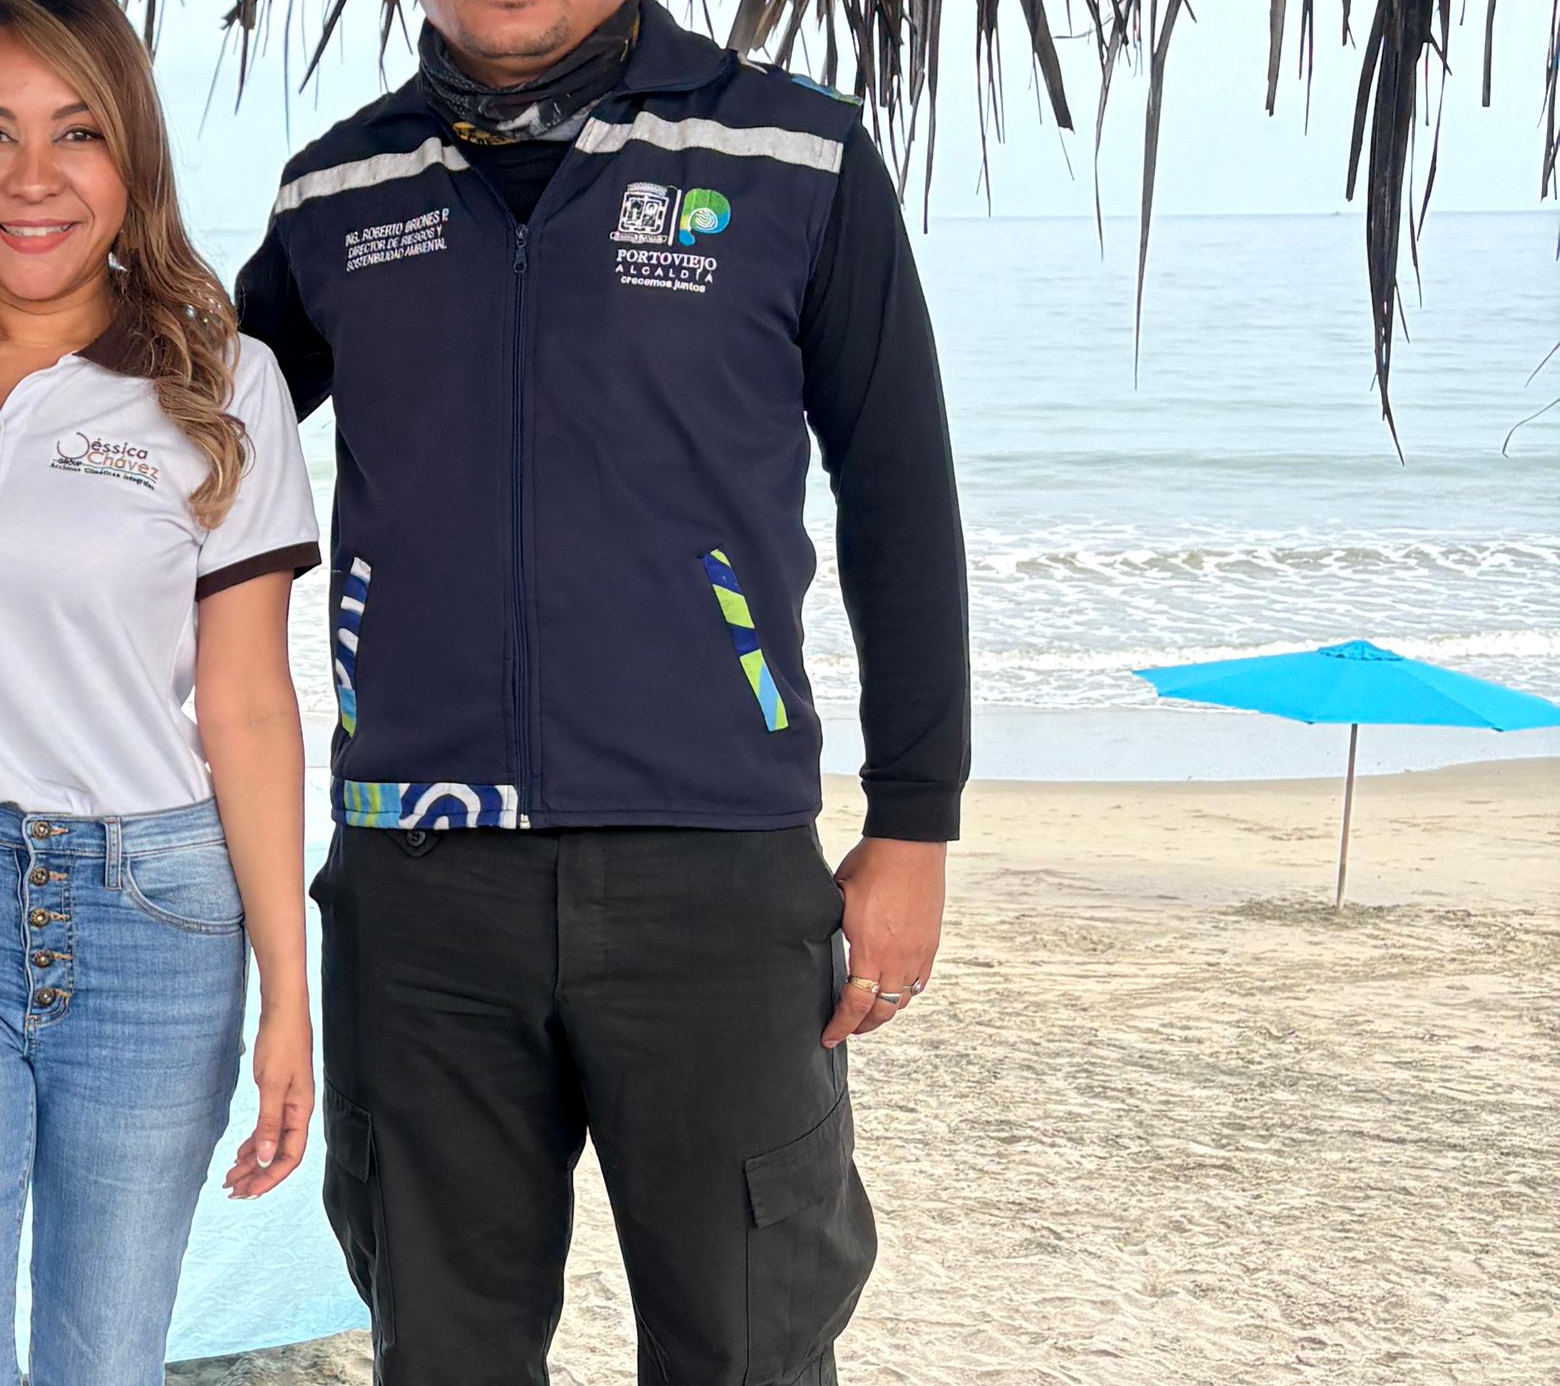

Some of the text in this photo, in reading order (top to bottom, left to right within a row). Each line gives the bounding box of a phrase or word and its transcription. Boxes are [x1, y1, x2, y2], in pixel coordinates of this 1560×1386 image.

[348, 224, 443, 259] DIRECTOR DE RIESGOS Y
[362, 222, 403, 240] ROBERTO
[346, 237, 447, 272] SOSTENIBILIDAD AMBIENTAL
[616, 249, 717, 271] PORTOVIEJO
[620, 275, 707, 294] crecemos juntos
[87, 450, 161, 481] Chávez
